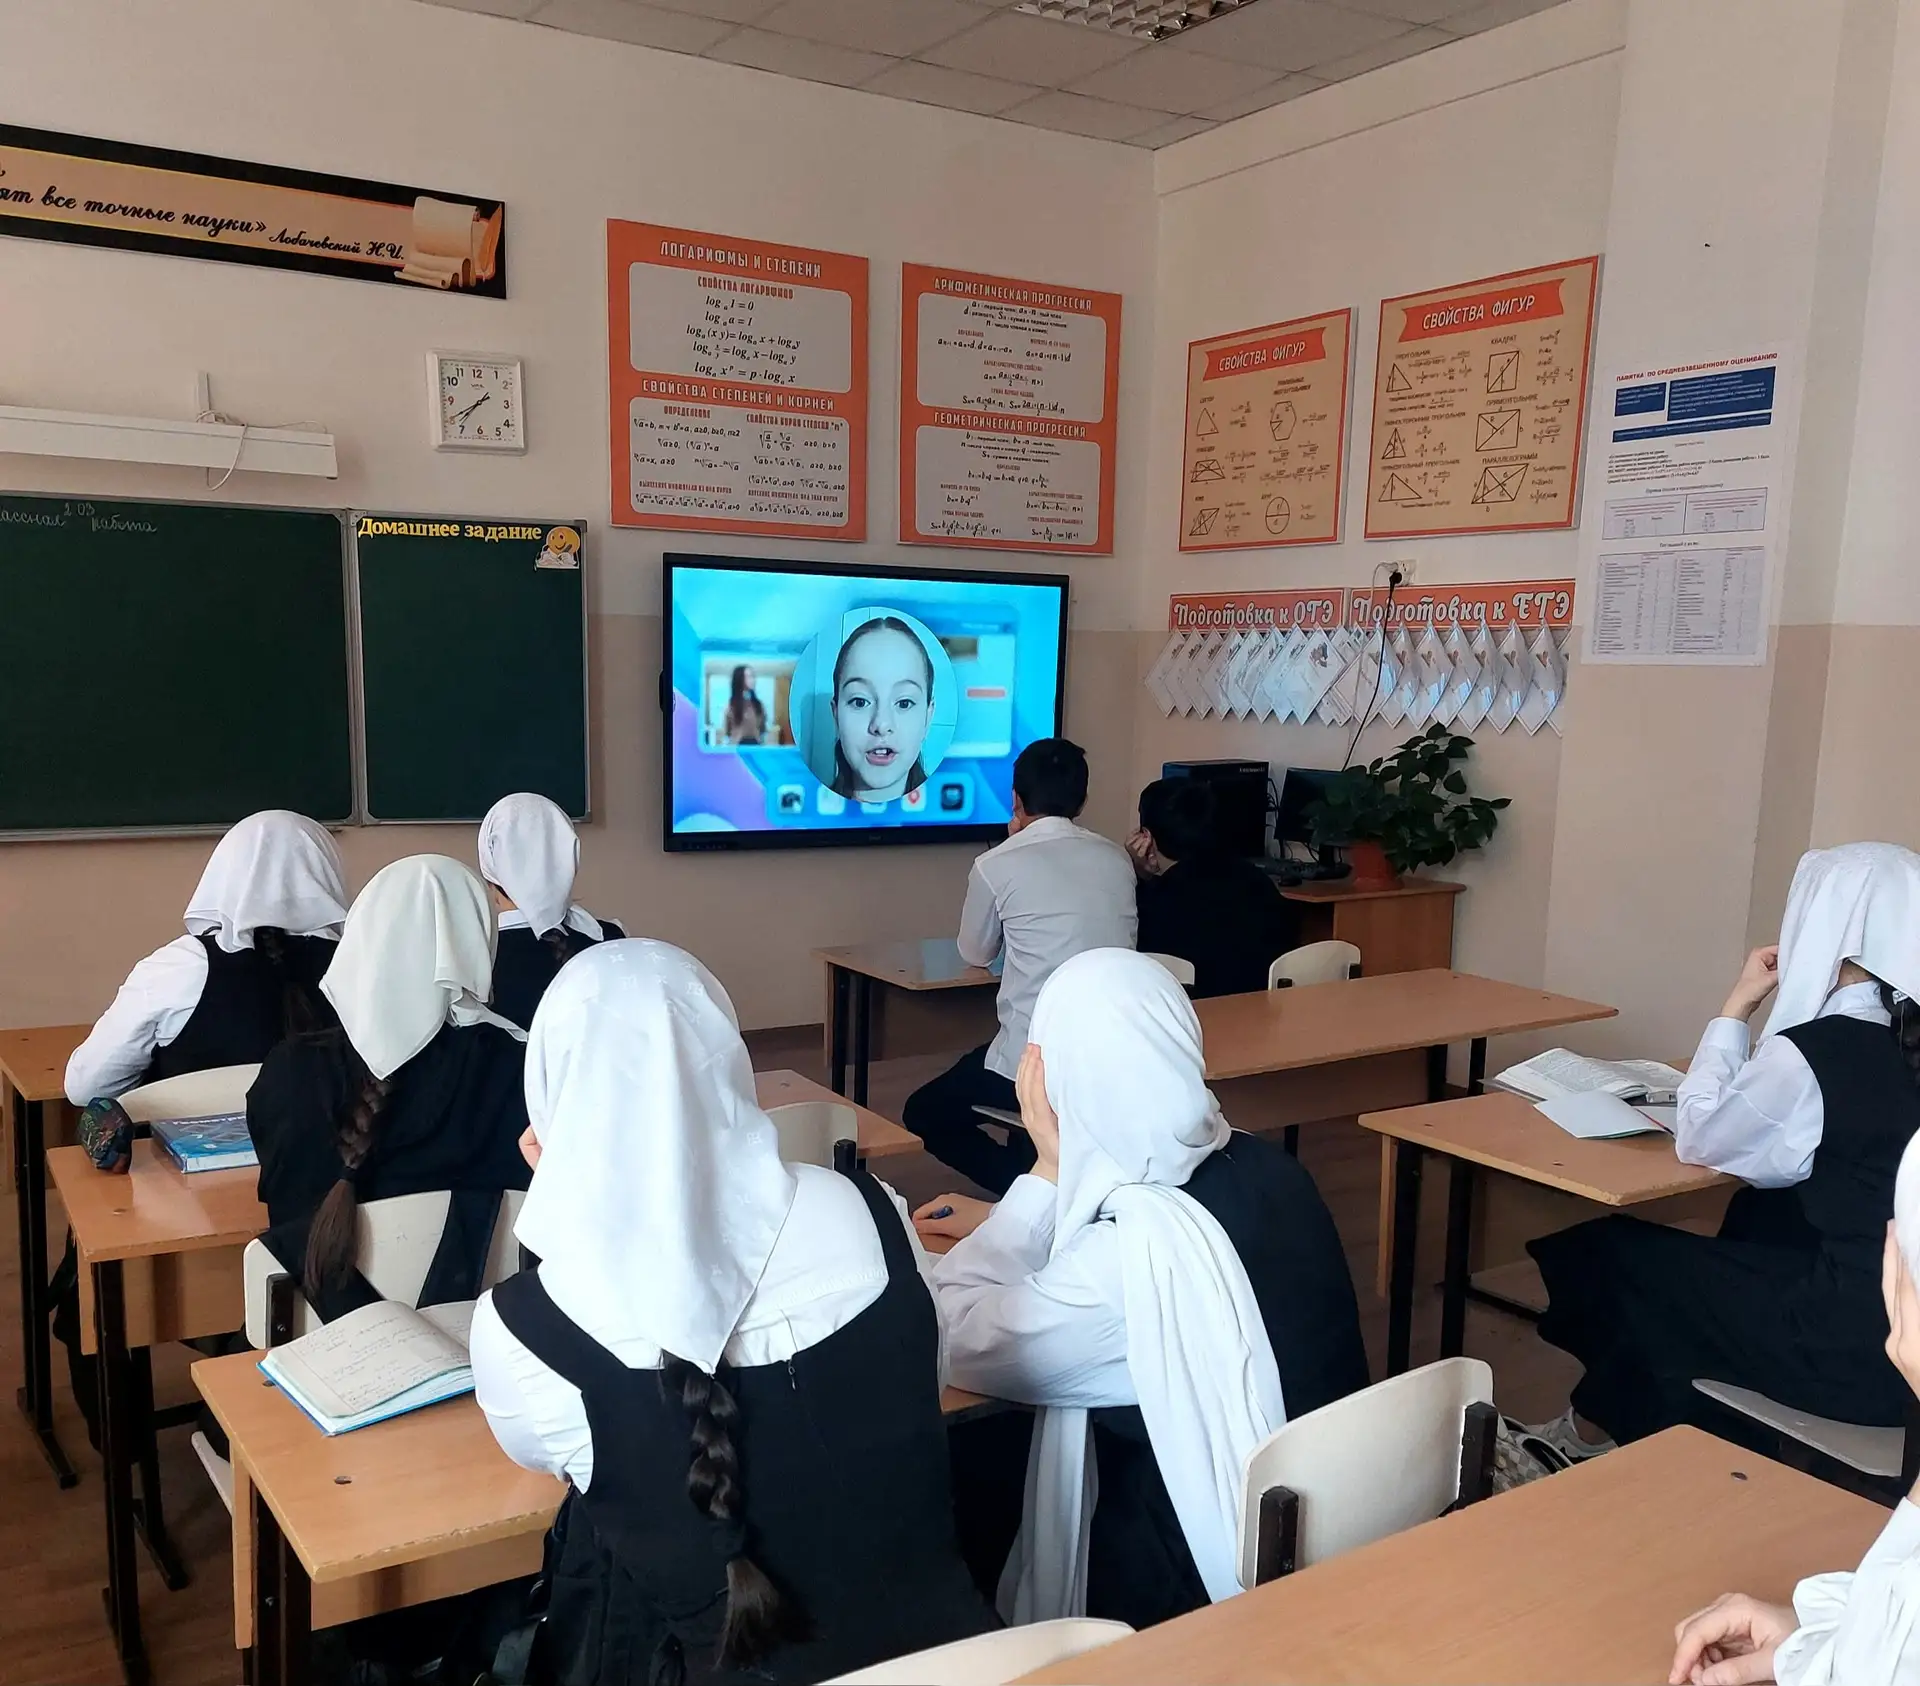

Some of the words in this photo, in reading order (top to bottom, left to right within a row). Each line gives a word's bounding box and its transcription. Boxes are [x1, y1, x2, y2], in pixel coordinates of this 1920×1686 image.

[41, 185, 77, 209] все
[83, 199, 176, 223] точные
[181, 212, 267, 238] науки»
[268, 228, 361, 254] Лобачевский
[660, 241, 748, 267] ЛОГАРИФМЫ
[753, 255, 761, 269] И
[766, 257, 821, 278] СТЕПЕНИ
[697, 276, 738, 293] СВОЙСТВА
[934, 278, 1028, 303] АРИФМЕТИЧЕСКАЯ
[1031, 293, 1092, 311] ПРОГРЕССИЯ
[1423, 304, 1484, 330] СВОЙСТВА
[1492, 295, 1535, 317] ФИГУР
[1219, 348, 1267, 371] СВОЙСТВА
[1272, 341, 1306, 360] ФИГУР
[455, 367, 464, 378] 11
[472, 369, 483, 379] 12
[494, 370, 499, 380] 1
[446, 376, 459, 387] 10
[502, 380, 509, 390] 2
[447, 395, 455, 406] 9
[643, 379, 707, 397] СВОЙСТВА
[712, 386, 772, 404] СТЕПЕНЕЙ
[776, 393, 783, 406] И
[788, 394, 834, 411] КОРНЕЙ
[503, 400, 510, 410] 3
[459, 424, 465, 434] 7
[477, 425, 484, 435] 6
[495, 427, 502, 436] 5
[503, 419, 510, 428] 4
[933, 411, 1023, 432] ГЕОМЕТРИЧЕСКАЯ
[1026, 420, 1087, 438] ПРОГРЕССИЯ
[0, 509, 66, 527] ассная
[91, 514, 158, 533] работа
[358, 517, 460, 539] Домашнее
[464, 524, 542, 542] задание
[1173, 601, 1275, 626] Подготовка
[1279, 607, 1289, 624] к
[1293, 599, 1334, 624] ОГЭ
[1353, 595, 1487, 622] Подготовка
[1492, 601, 1505, 620] к
[1512, 590, 1570, 620] ЕГЭ
